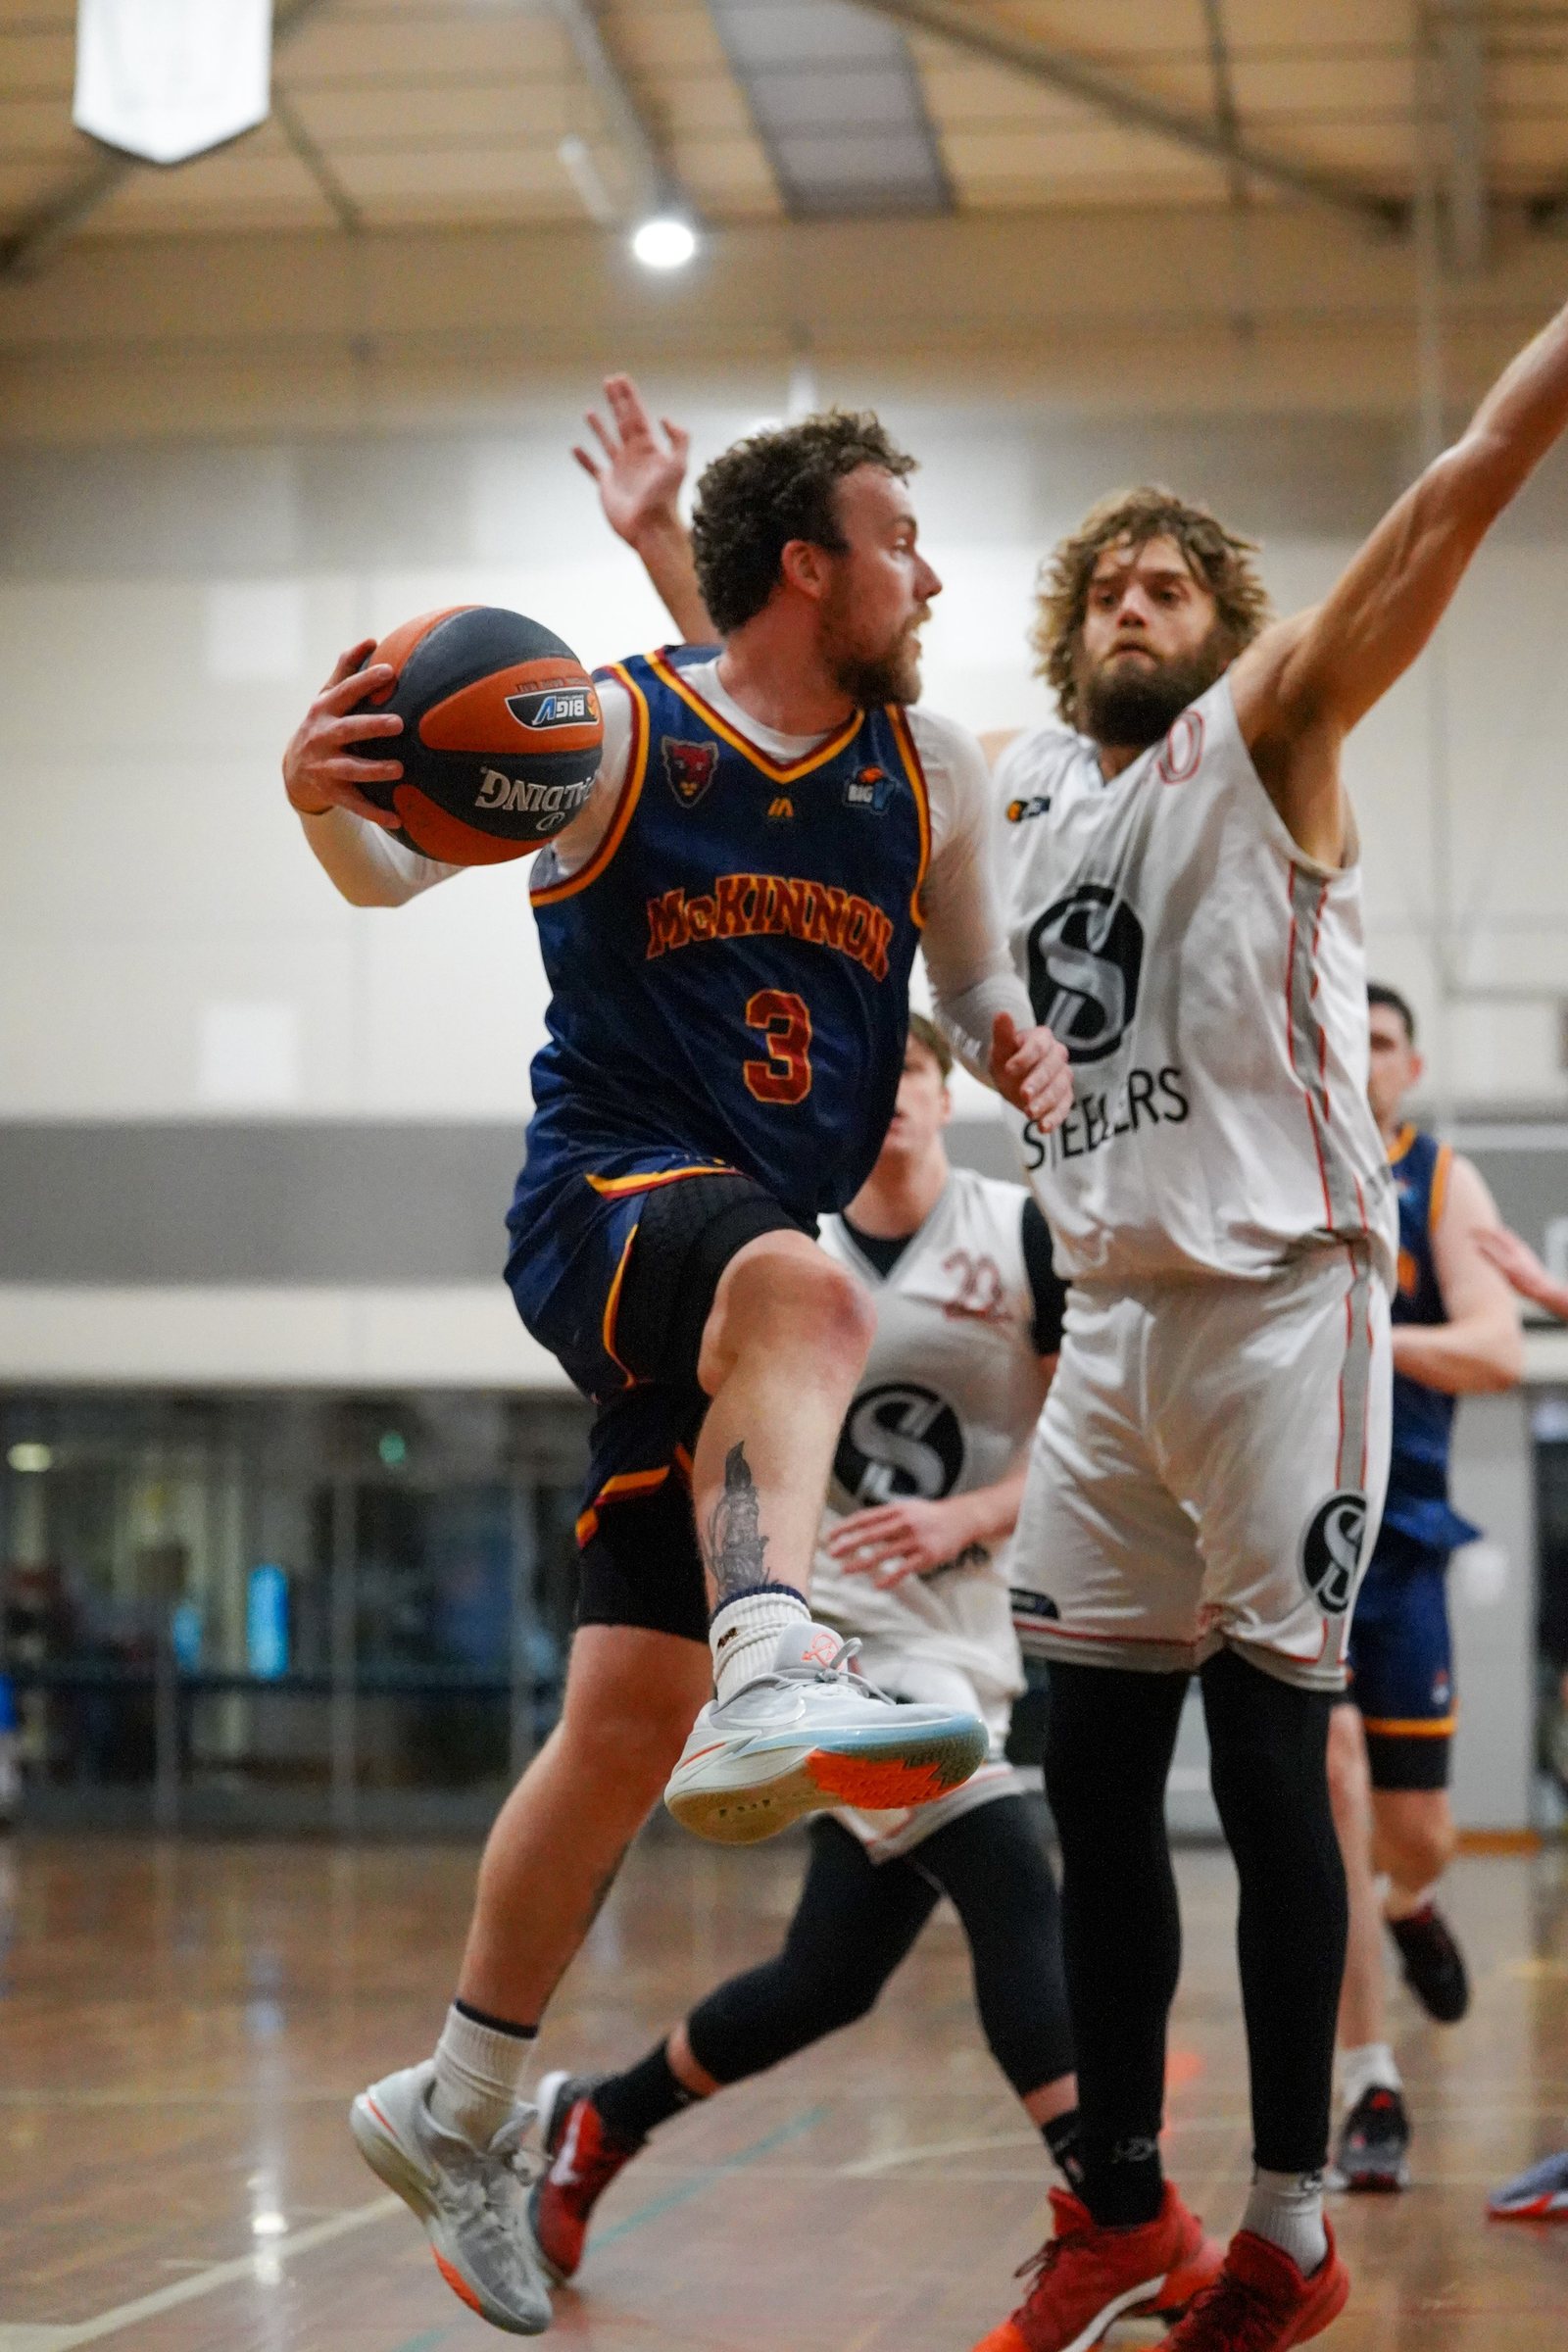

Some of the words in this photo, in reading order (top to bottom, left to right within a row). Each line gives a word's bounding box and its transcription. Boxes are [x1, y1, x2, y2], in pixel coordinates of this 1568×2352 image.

[475, 767, 600, 811] ALDING
[743, 989, 812, 1104] 3
[1023, 1066, 1190, 1170] SEELRS
